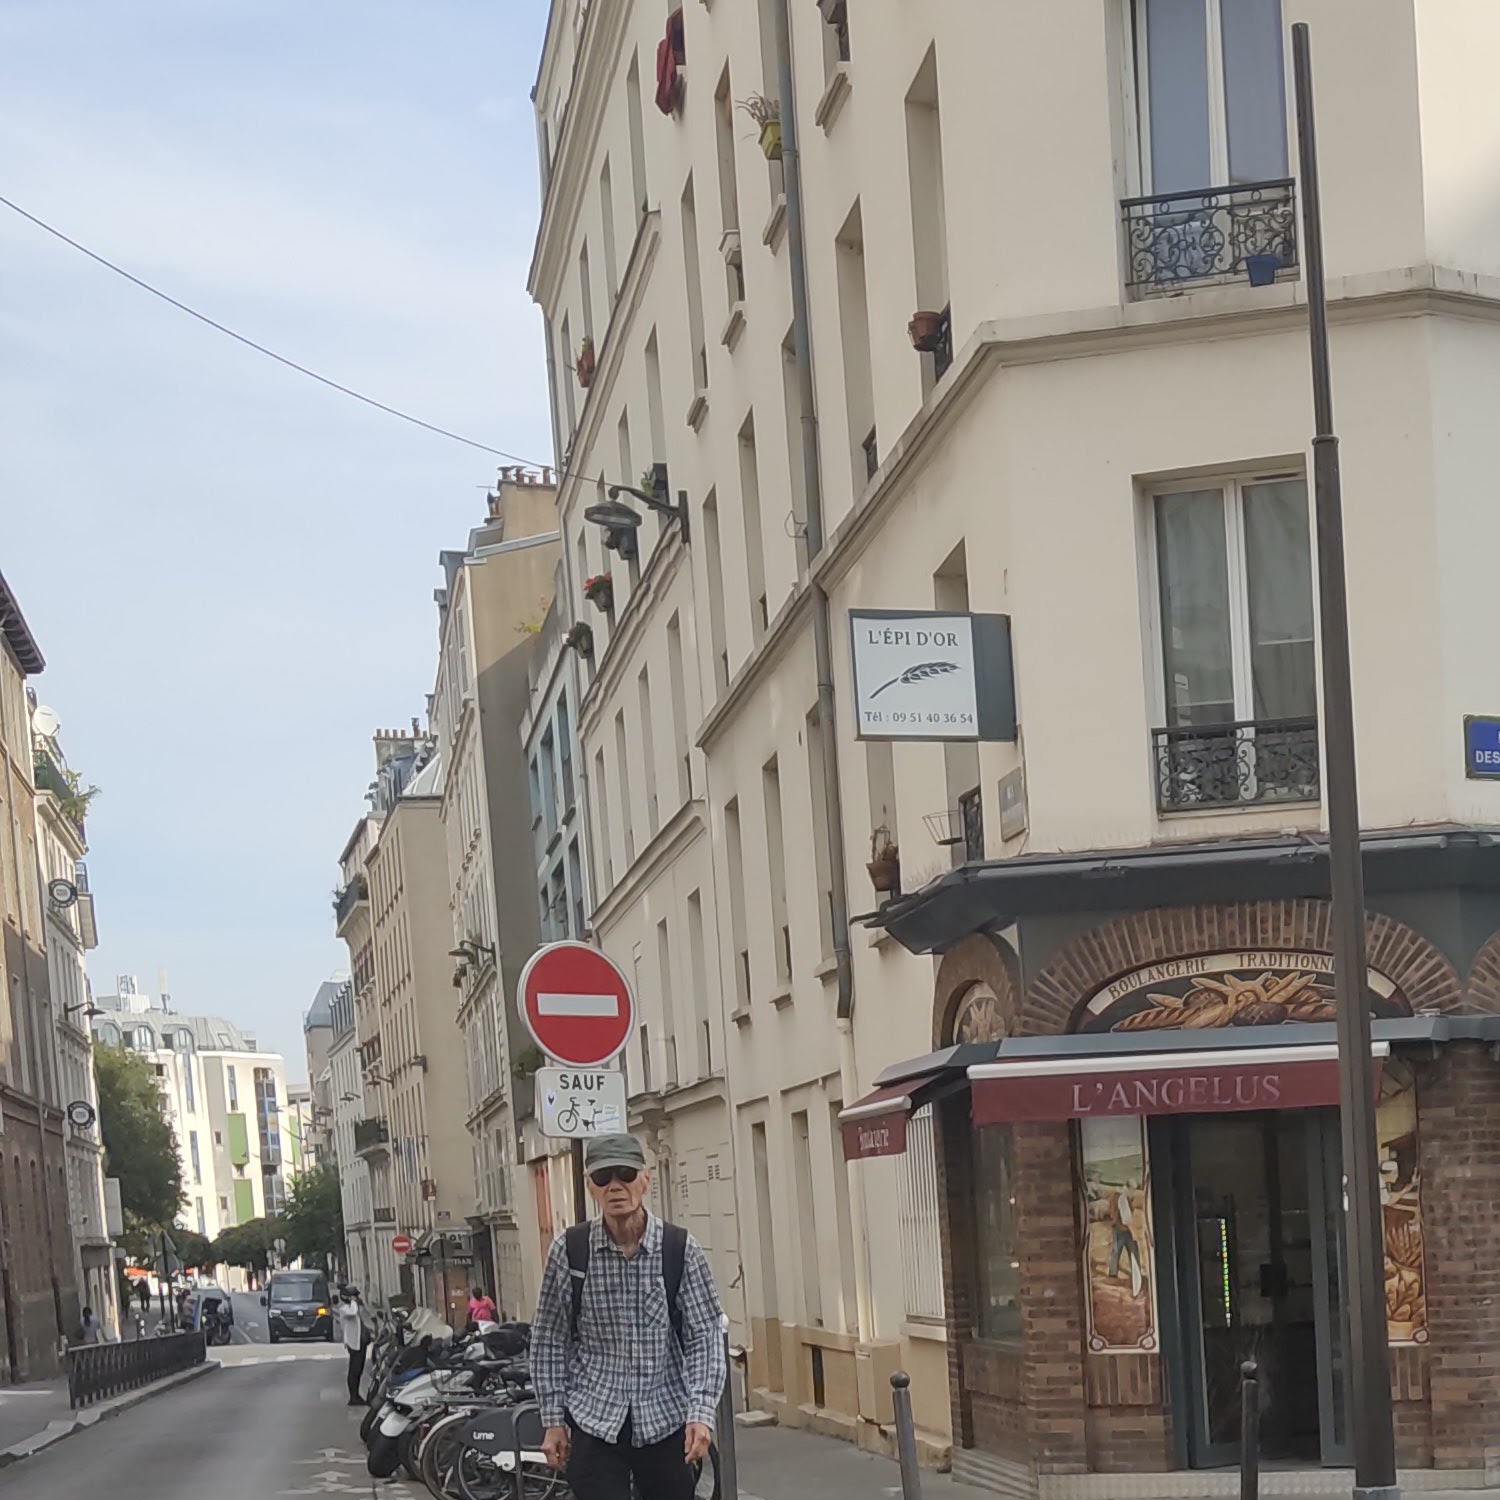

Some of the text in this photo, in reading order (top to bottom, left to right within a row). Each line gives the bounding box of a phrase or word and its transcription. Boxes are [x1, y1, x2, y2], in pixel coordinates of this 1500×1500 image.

[868, 628, 958, 647] L'ÉPI D'OR
[892, 712, 906, 723] 09
[910, 713, 922, 723] 51
[926, 713, 940, 723] 40
[944, 713, 956, 723] 36
[960, 713, 973, 723] 54
[1475, 750, 1500, 764] DES
[1108, 953, 1335, 999] BOULANGERIE TRADITIONN
[560, 1074, 605, 1091] SAUF
[1072, 1075, 1280, 1112] L'ANGELUS
